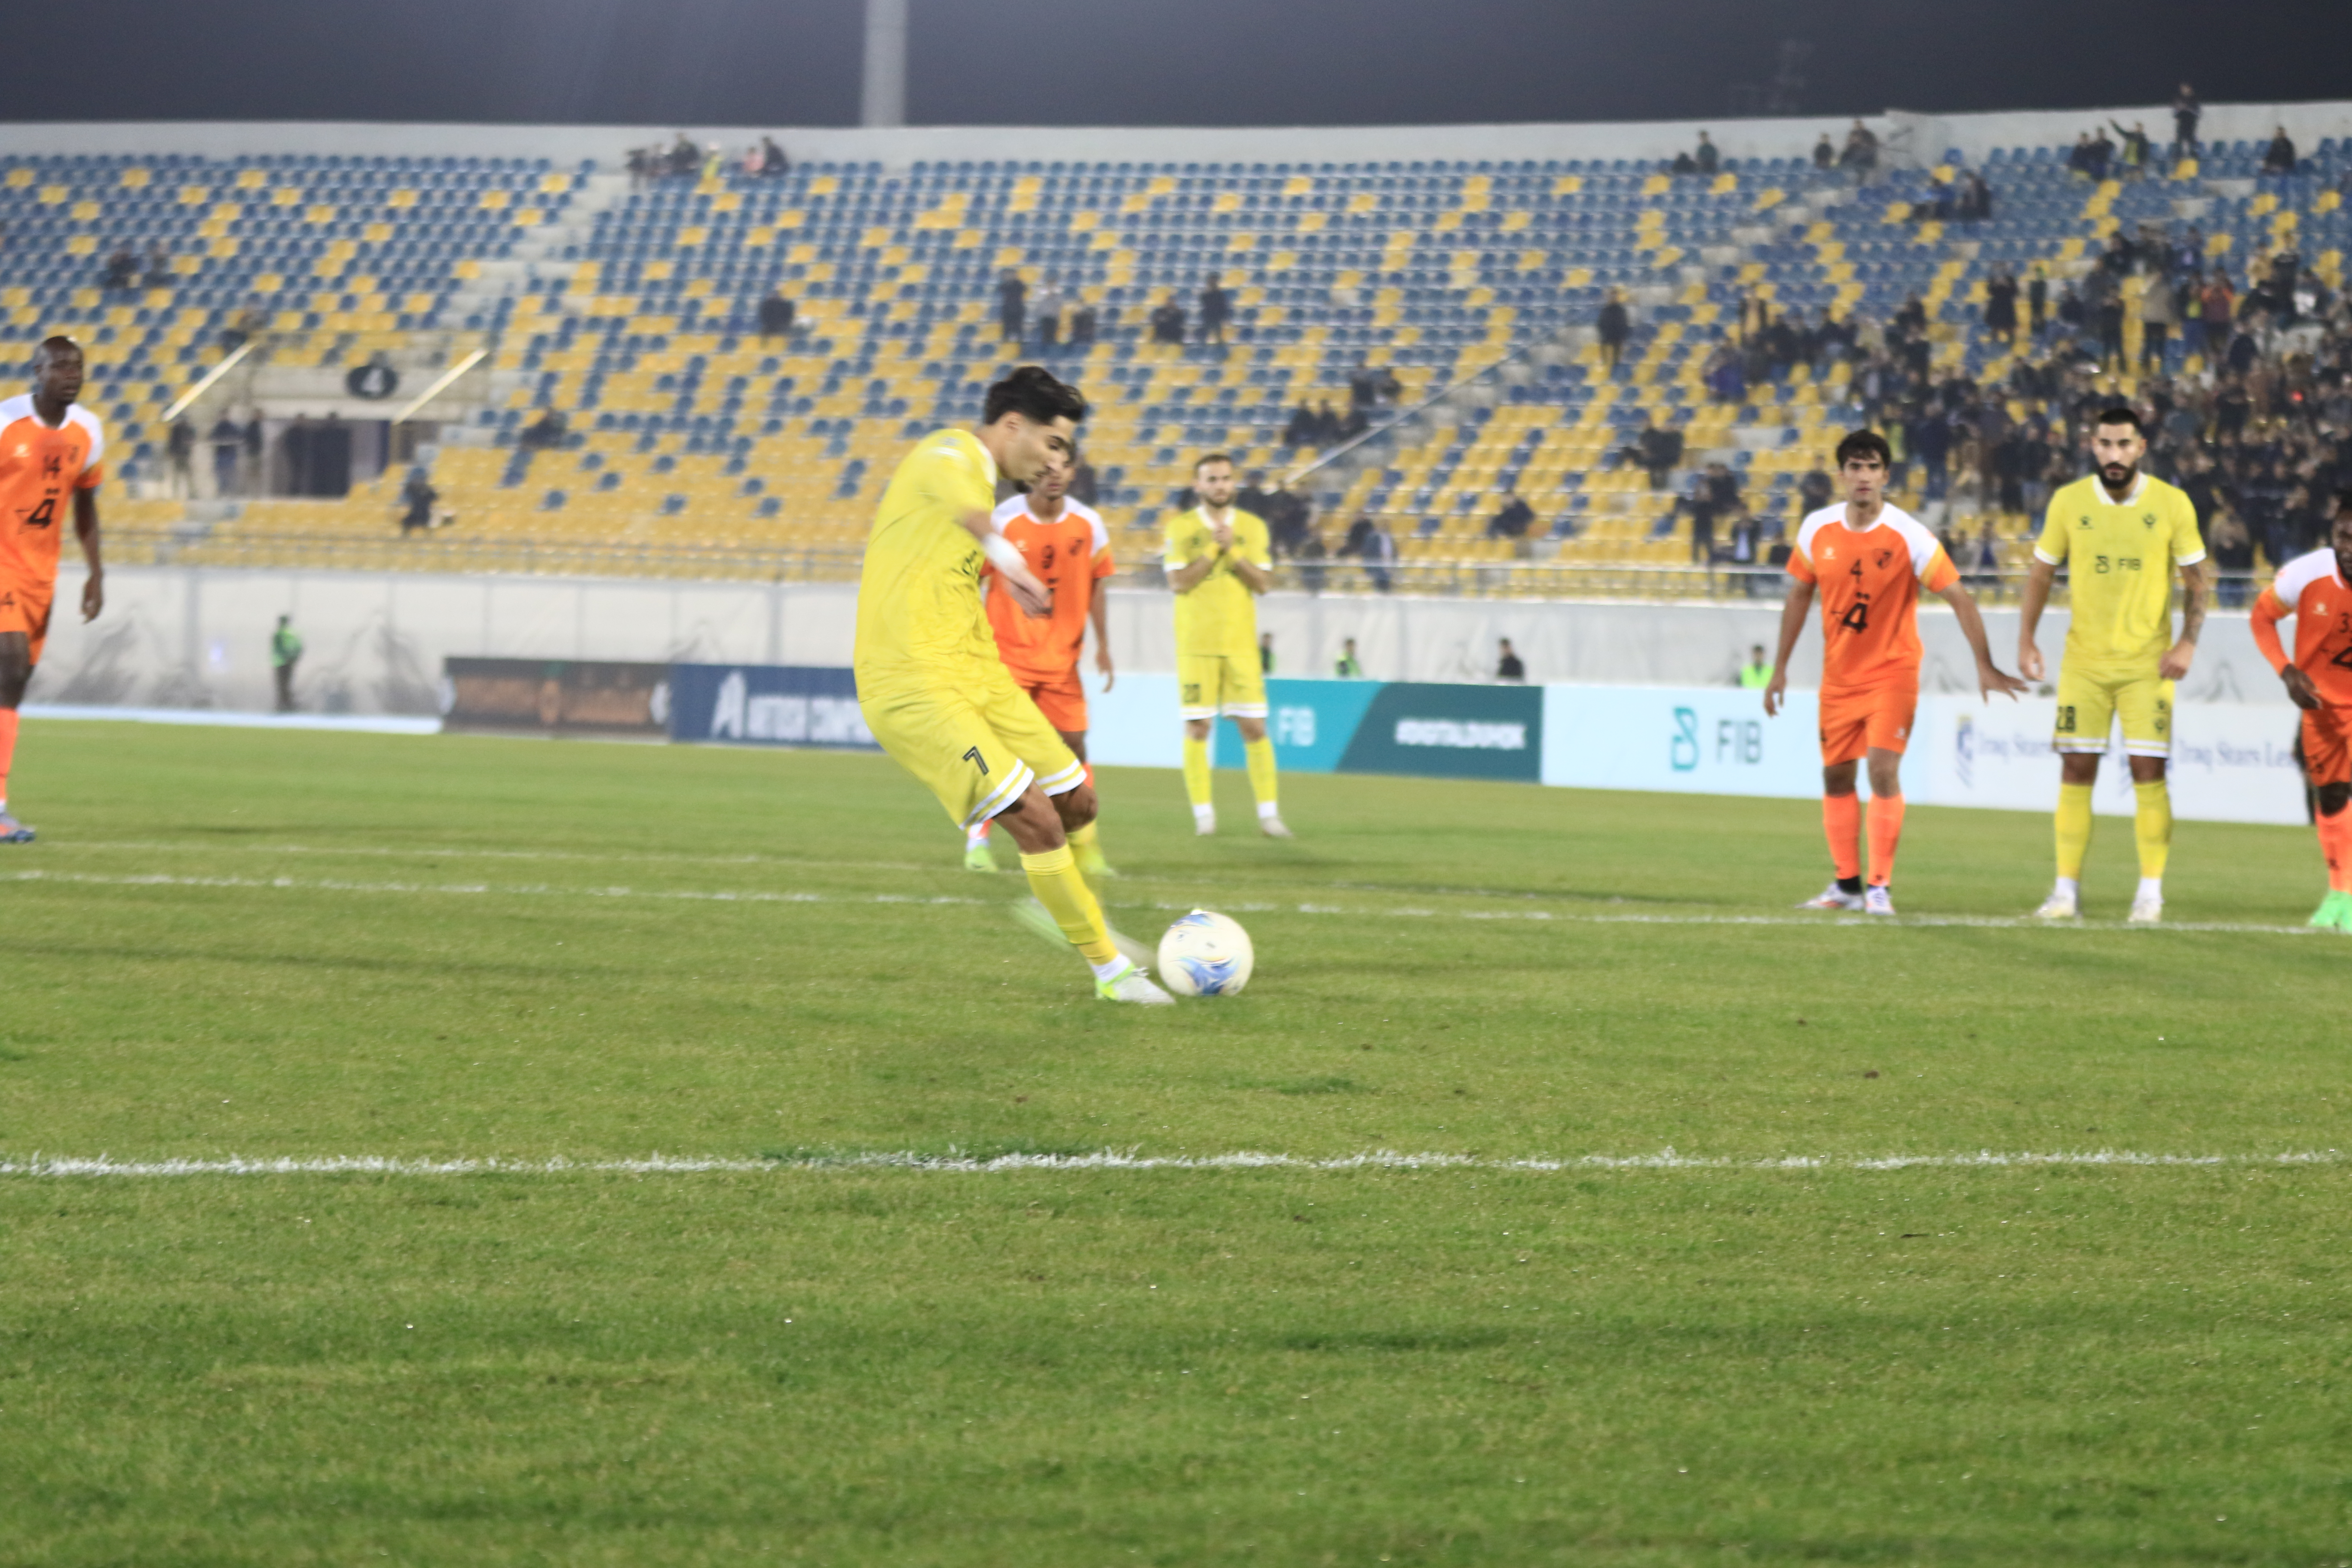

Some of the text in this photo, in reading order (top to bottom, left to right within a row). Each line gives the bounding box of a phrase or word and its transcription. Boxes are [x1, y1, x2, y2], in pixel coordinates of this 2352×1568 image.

[361, 369, 384, 396] 4
[1850, 559, 1863, 584] 4
[2118, 558, 2141, 571] FIB
[2057, 705, 2076, 732] 28
[1718, 719, 1763, 764] FIB
[962, 746, 989, 776] 7
